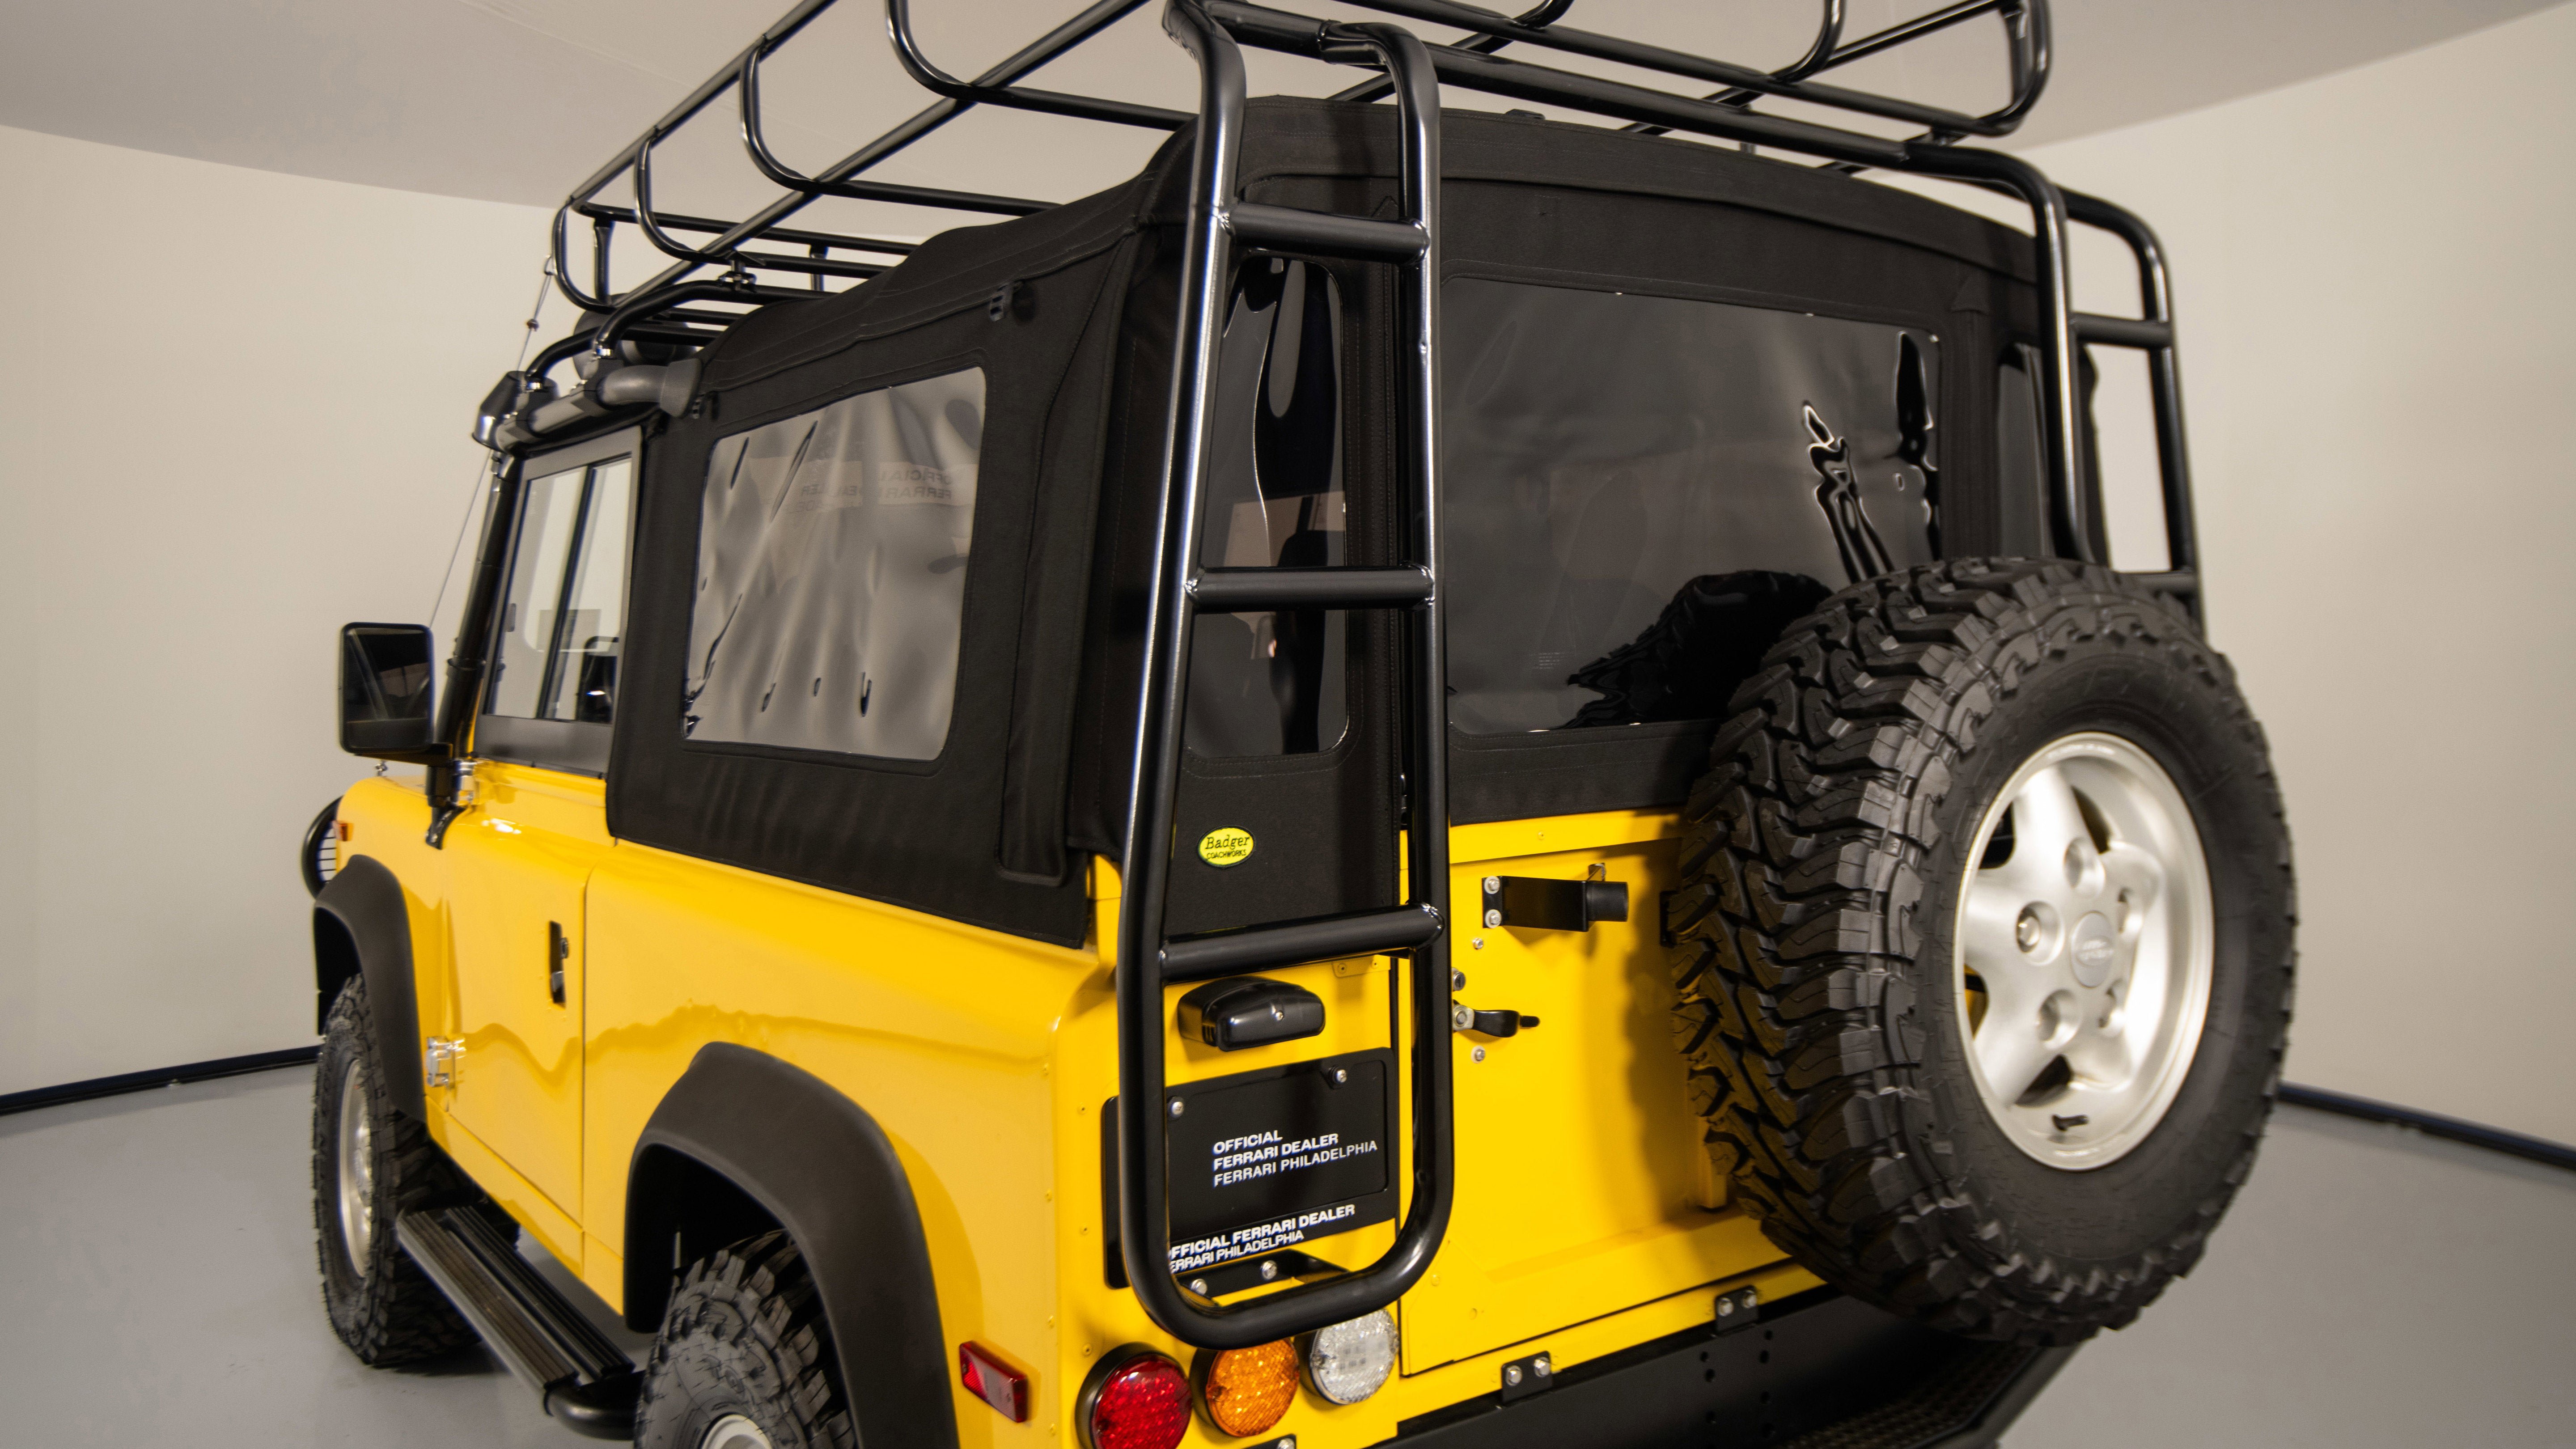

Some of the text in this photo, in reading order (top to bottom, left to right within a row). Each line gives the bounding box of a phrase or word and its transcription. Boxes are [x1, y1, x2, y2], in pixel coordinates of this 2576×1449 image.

[1204, 834, 1250, 850] Badger
[1207, 849, 1246, 860] COACHWORKS
[1213, 1130, 1283, 1155] OFFICIAL
[1213, 1133, 1339, 1172] FERRARI DEALER
[1213, 1140, 1378, 1188] FERRARI PHILADELPHIA
[1167, 1204, 1356, 1260] FFICIAL FERRARI DEALER
[1169, 1230, 1305, 1274] ERRARI PHILADELPHIA
